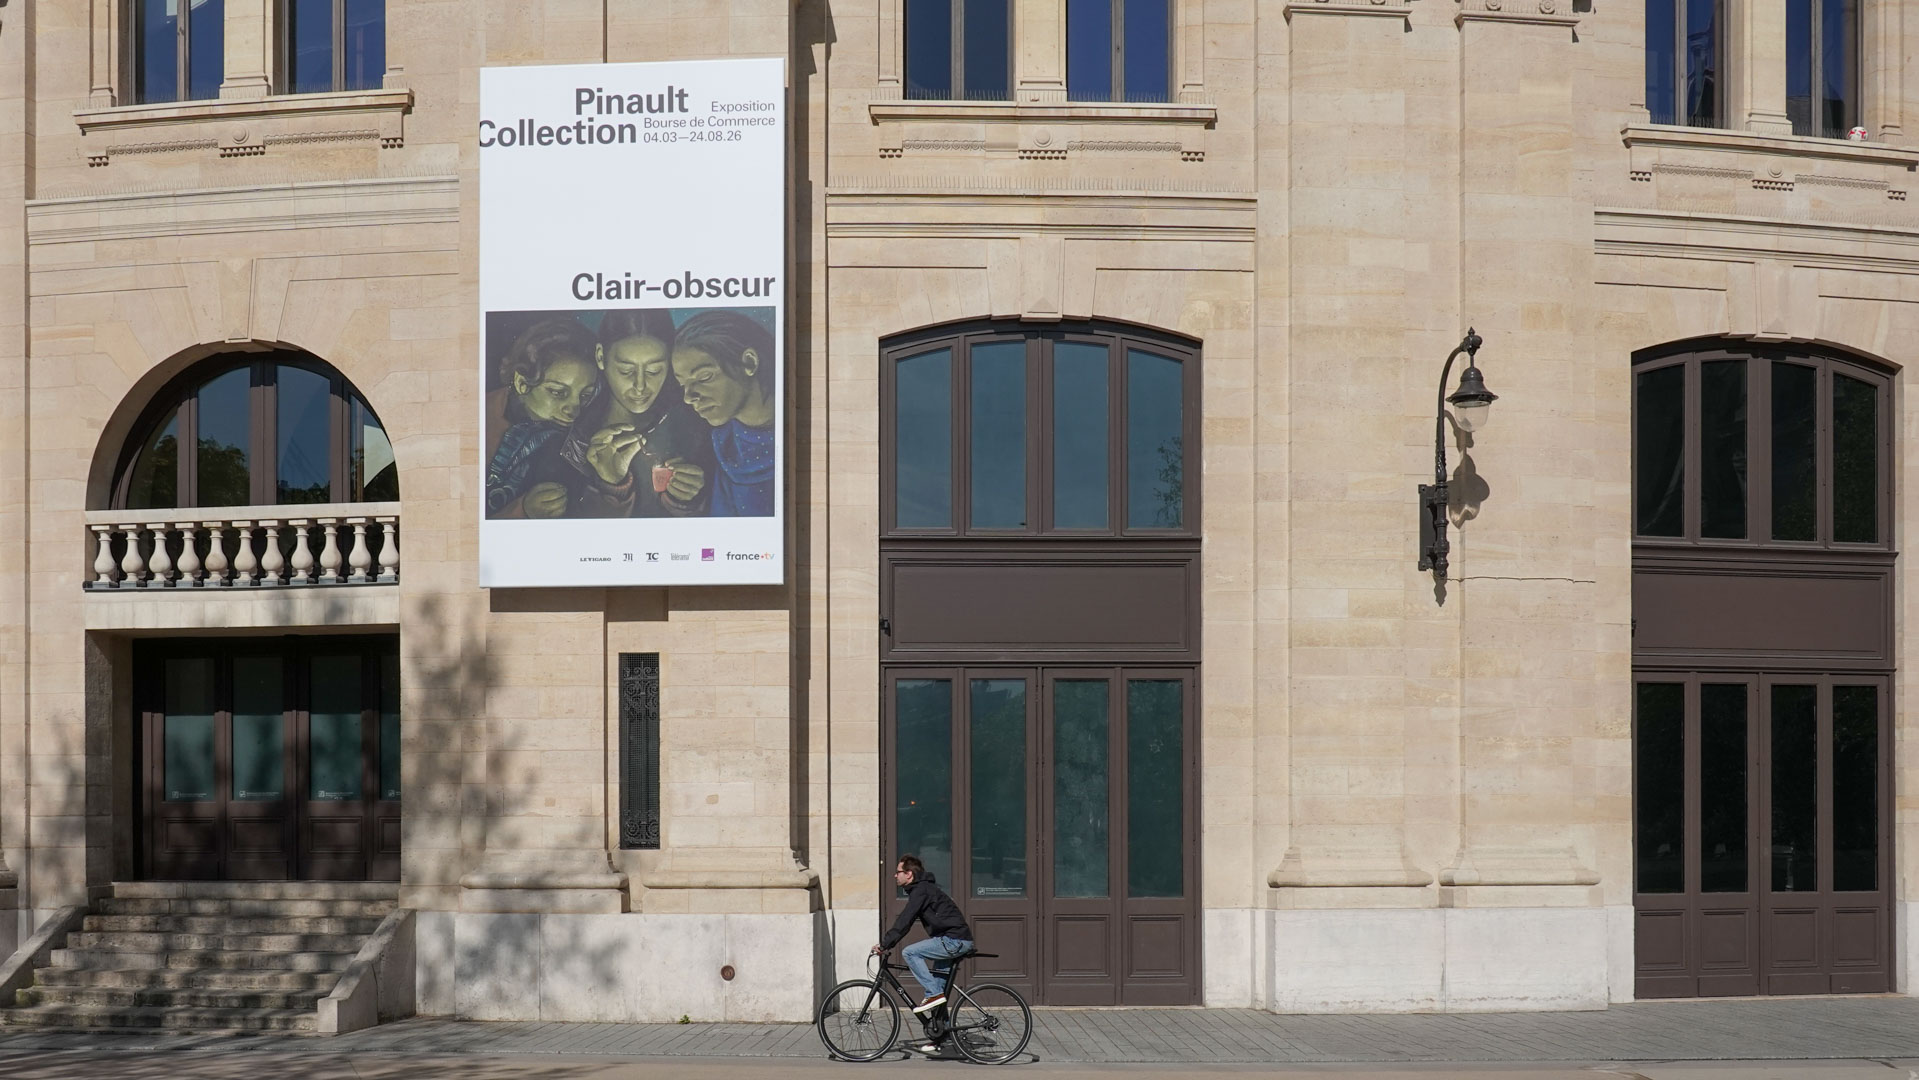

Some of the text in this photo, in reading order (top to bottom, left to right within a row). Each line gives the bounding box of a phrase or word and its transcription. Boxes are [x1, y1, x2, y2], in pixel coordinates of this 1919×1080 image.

[575, 85, 689, 116] Pinault
[711, 100, 776, 114] Exposition
[479, 117, 637, 148] Collection
[643, 115, 776, 129] Bourse de Commerce
